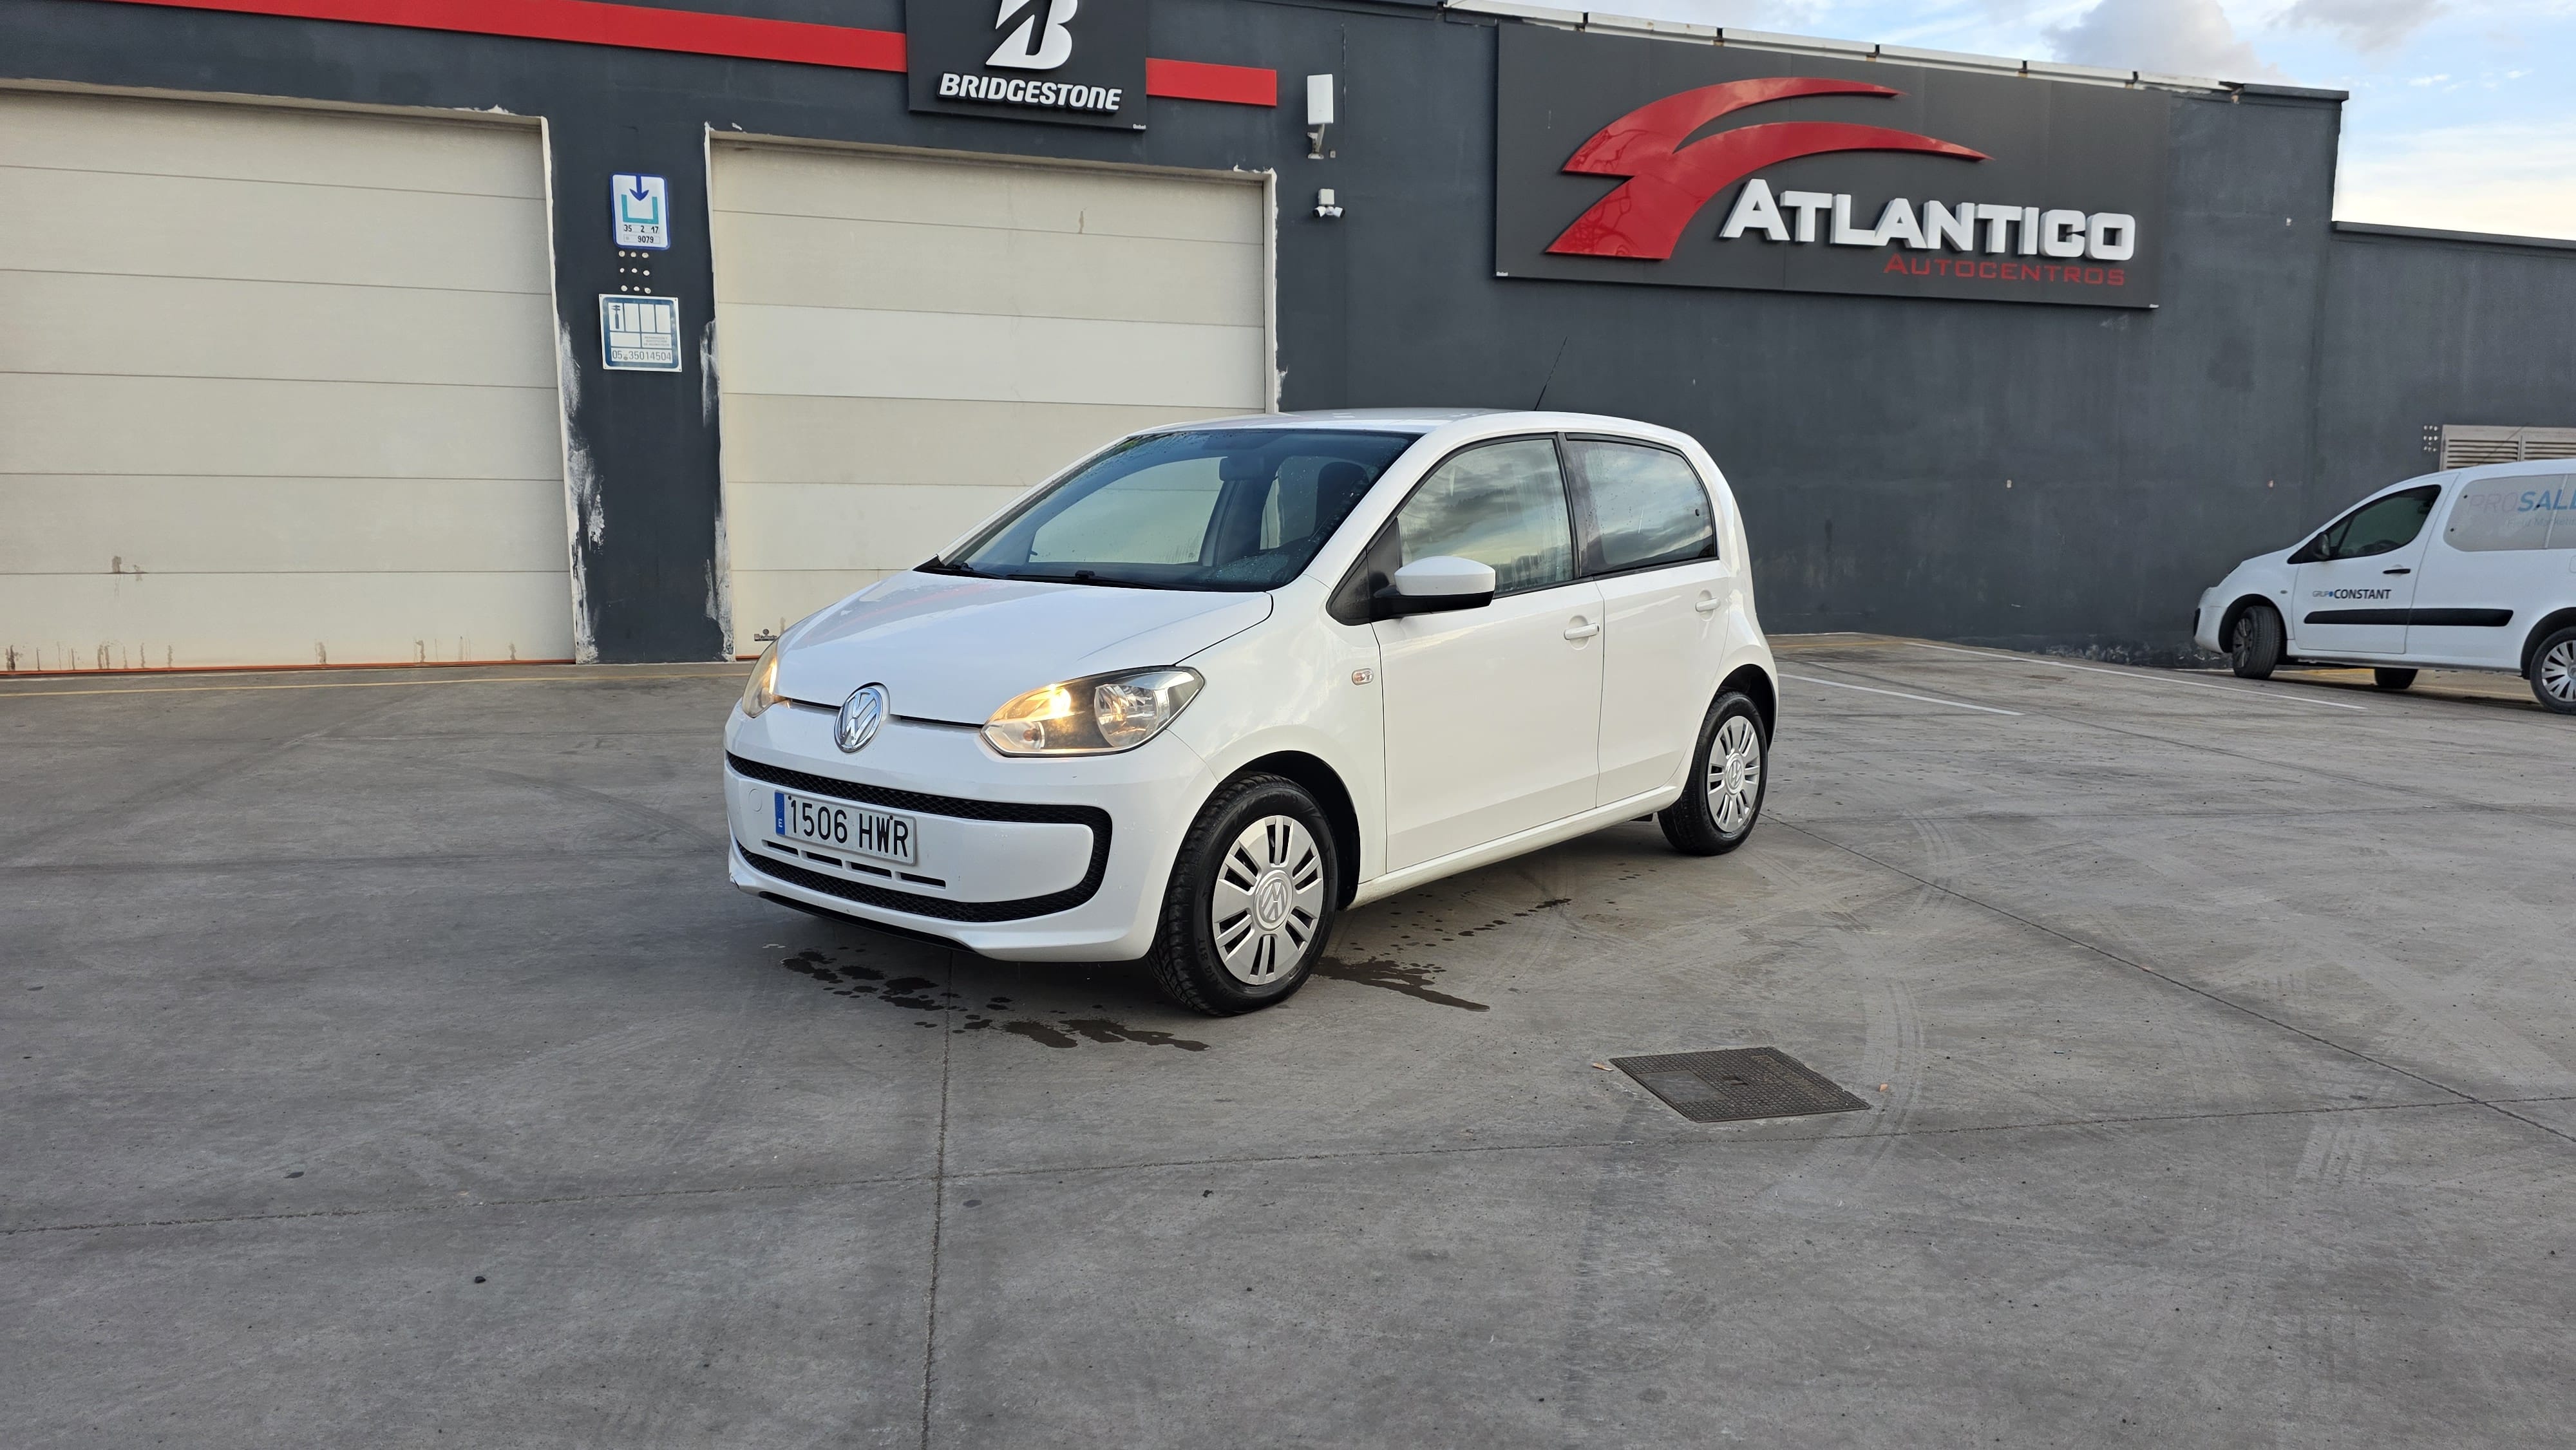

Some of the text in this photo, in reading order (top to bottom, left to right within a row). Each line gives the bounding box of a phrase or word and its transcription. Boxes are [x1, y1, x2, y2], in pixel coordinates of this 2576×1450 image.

[938, 73, 1122, 111] BRIDGESTONE
[1719, 178, 2136, 261] ATLANTICO
[638, 235, 654, 243] 9079
[1883, 253, 2125, 286] AUTOCENTROS
[777, 818, 783, 828] E
[790, 799, 909, 858] 1506 HWR
